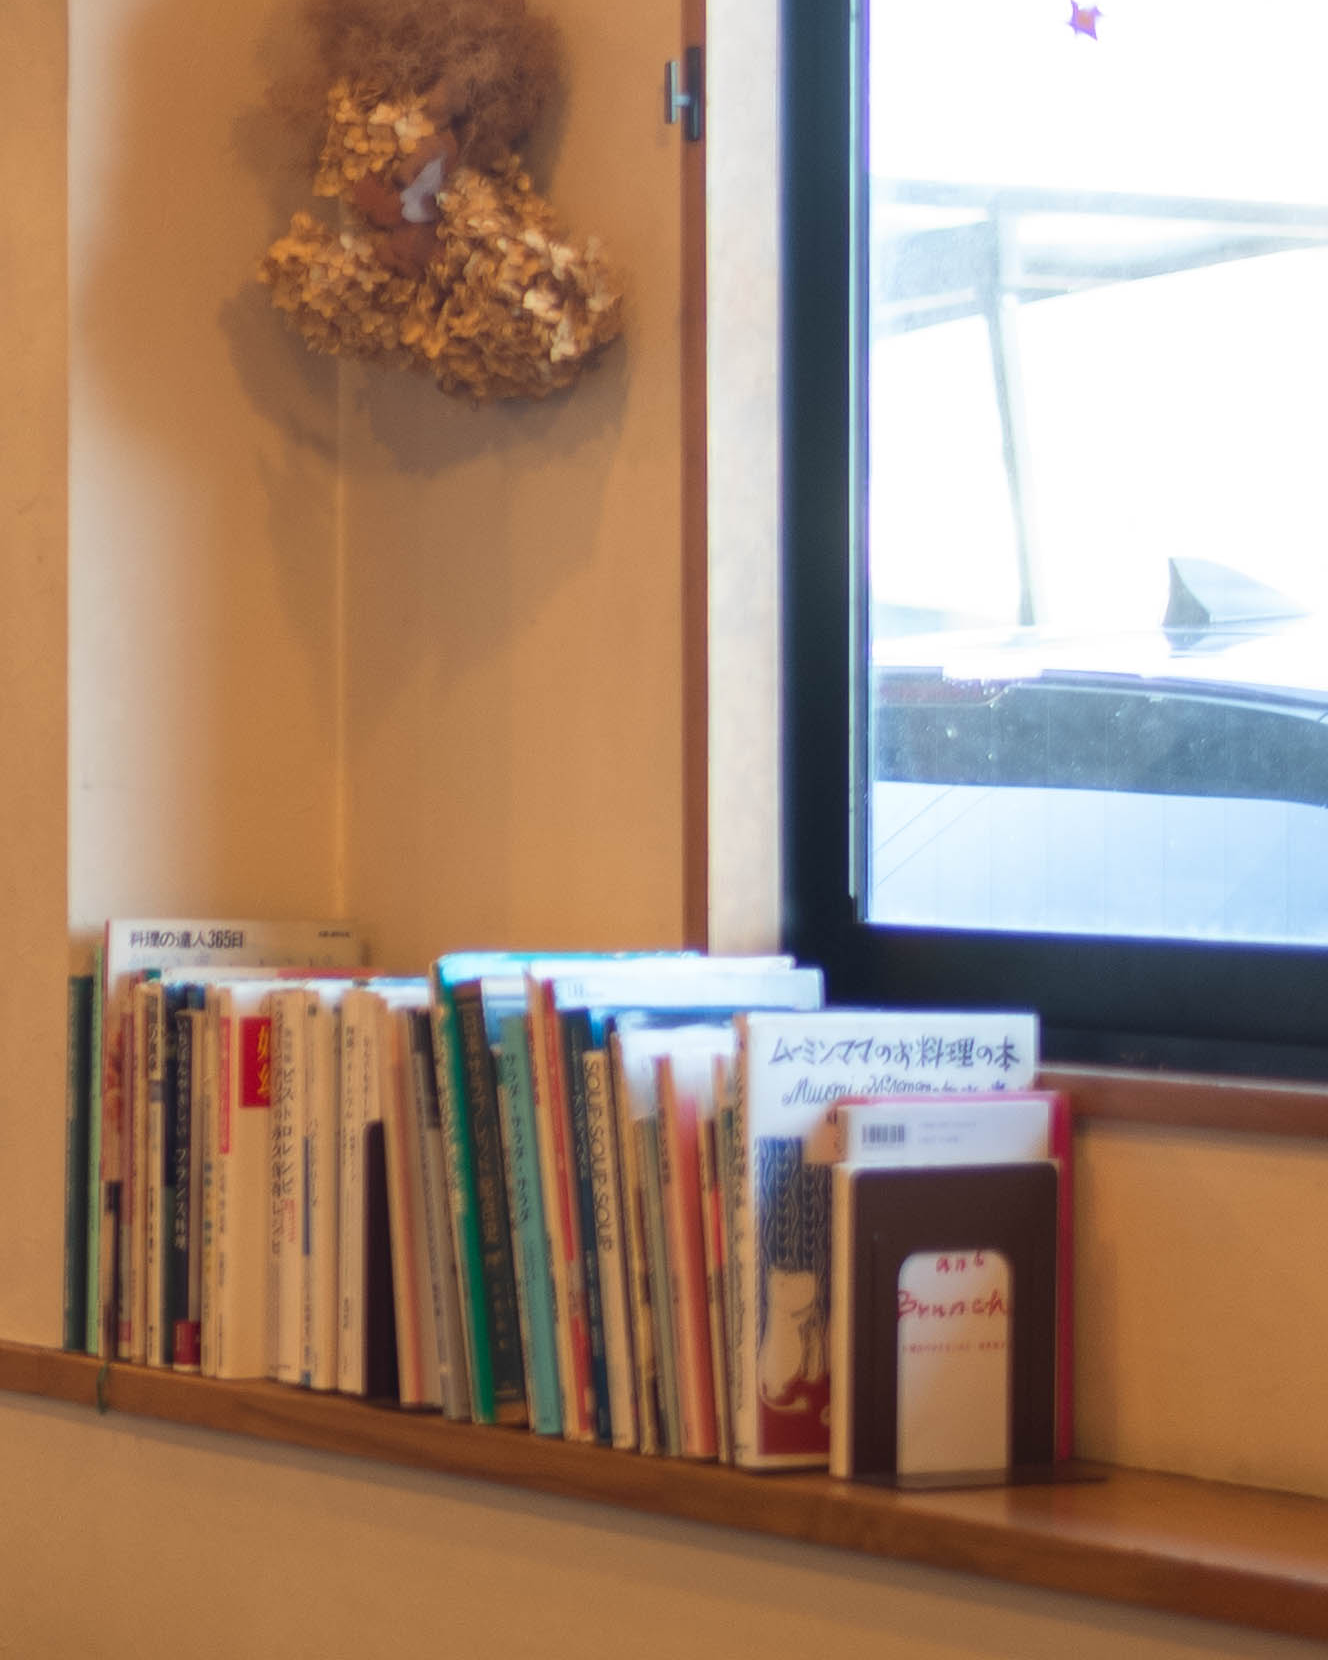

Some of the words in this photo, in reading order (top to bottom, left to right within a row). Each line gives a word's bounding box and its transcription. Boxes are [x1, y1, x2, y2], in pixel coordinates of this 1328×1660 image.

[769, 1034, 1020, 1071] ムーミンママのお料理の本
